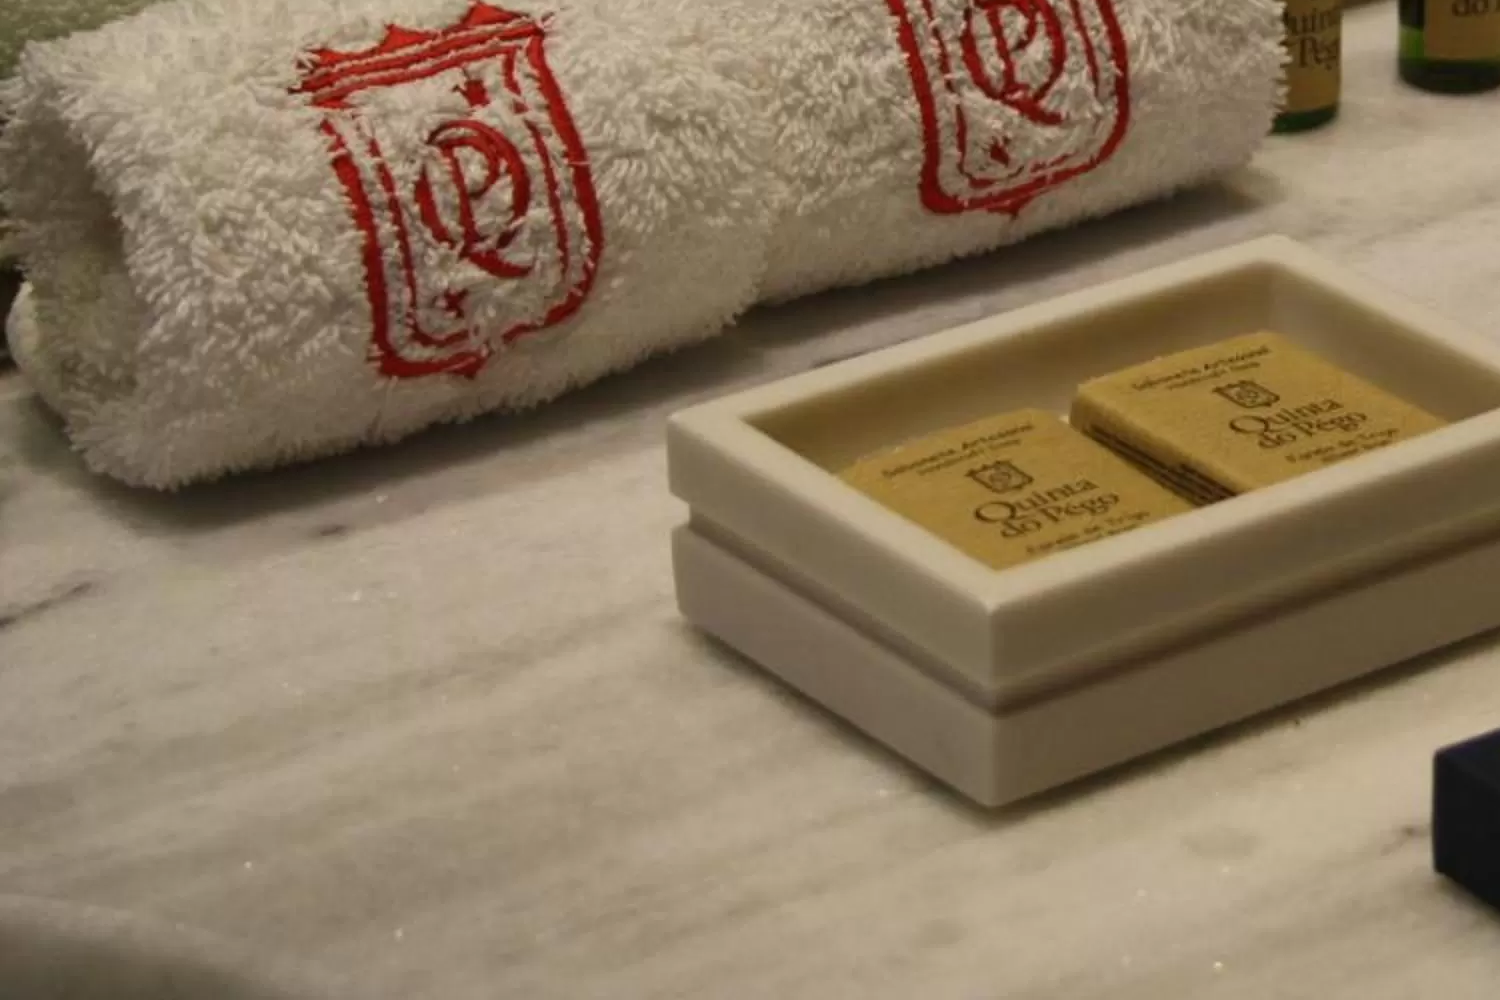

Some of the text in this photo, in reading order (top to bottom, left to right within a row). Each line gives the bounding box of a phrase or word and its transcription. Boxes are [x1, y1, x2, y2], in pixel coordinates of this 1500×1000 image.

[1229, 398, 1344, 434] Quinta
[1258, 428, 1297, 450] do
[974, 477, 1100, 524] Quinta
[1000, 515, 1042, 538] do
